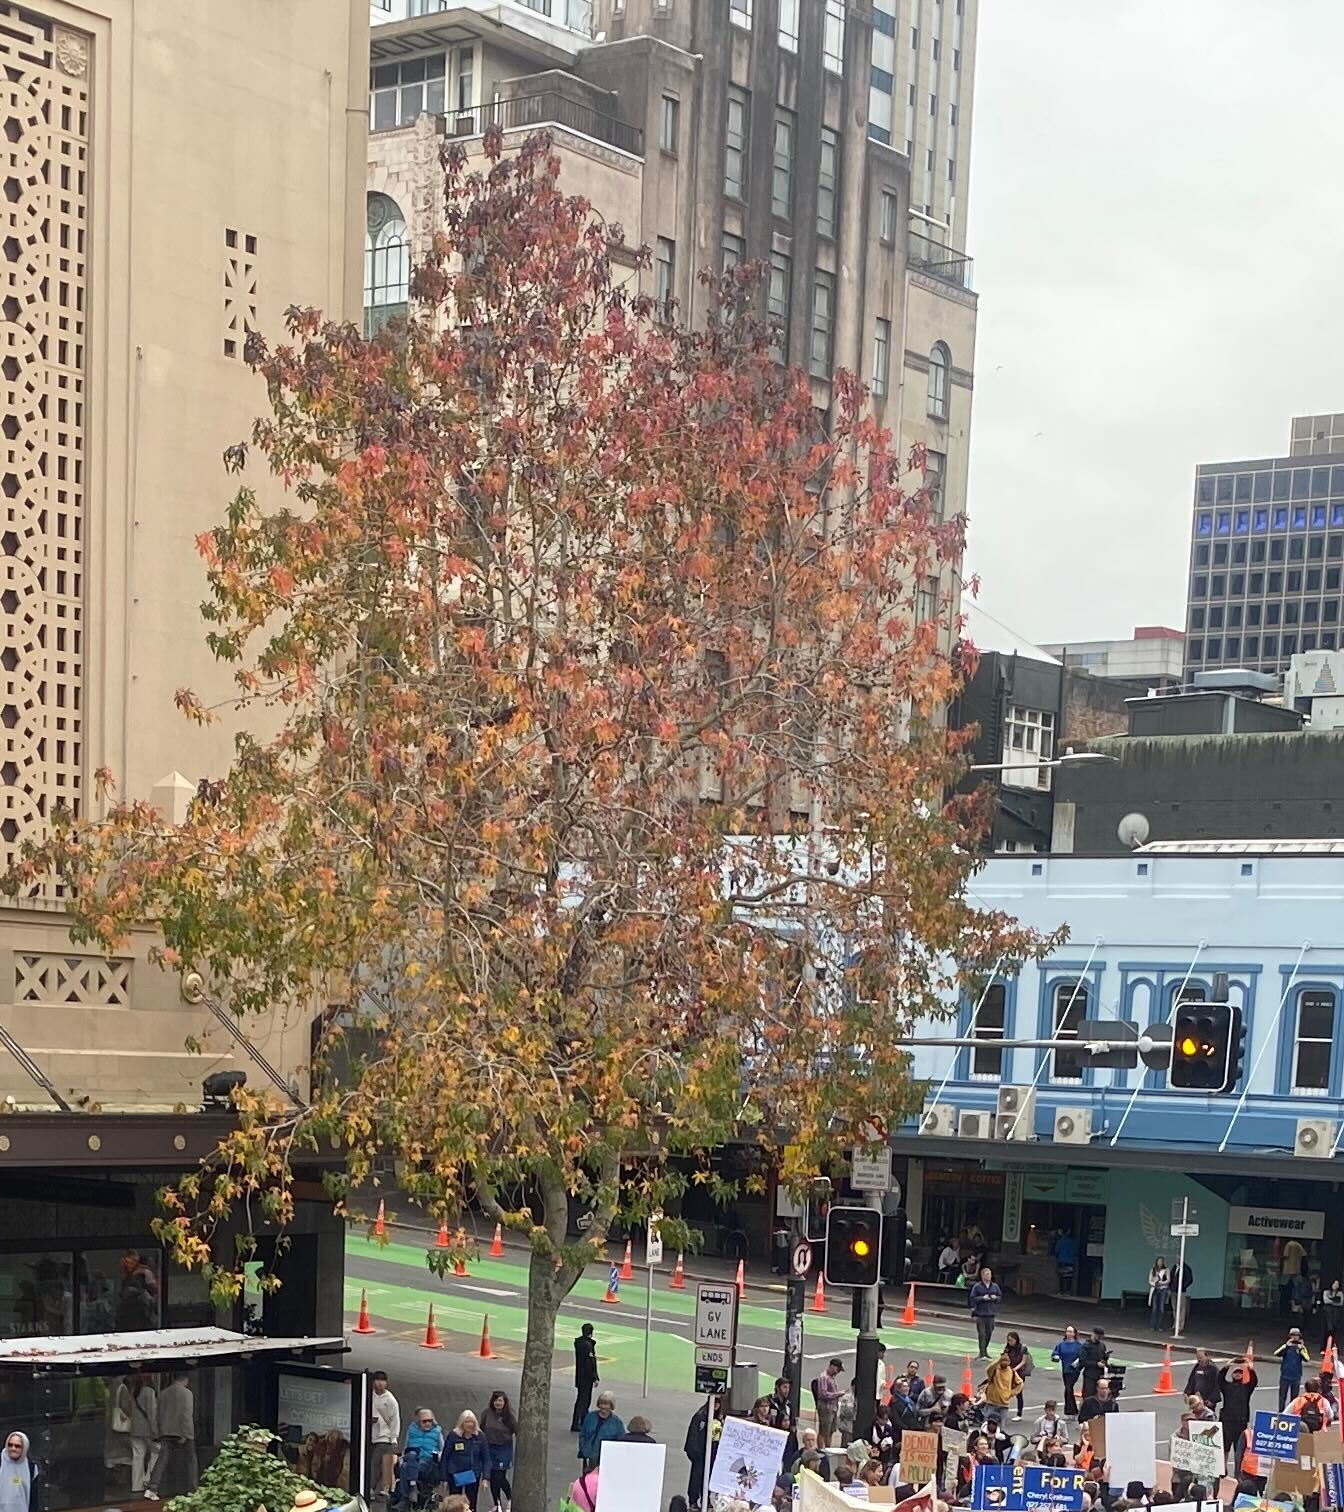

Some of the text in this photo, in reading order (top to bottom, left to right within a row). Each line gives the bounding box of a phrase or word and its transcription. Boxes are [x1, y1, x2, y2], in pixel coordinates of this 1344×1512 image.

[1248, 1214, 1306, 1231] Activewear
[708, 1311, 721, 1322] GV
[700, 1327, 727, 1340] LANE
[702, 1352, 723, 1362] ENDS
[1269, 1416, 1296, 1432] For
[904, 1435, 937, 1450] DENIAL
[1041, 1472, 1069, 1489] For
